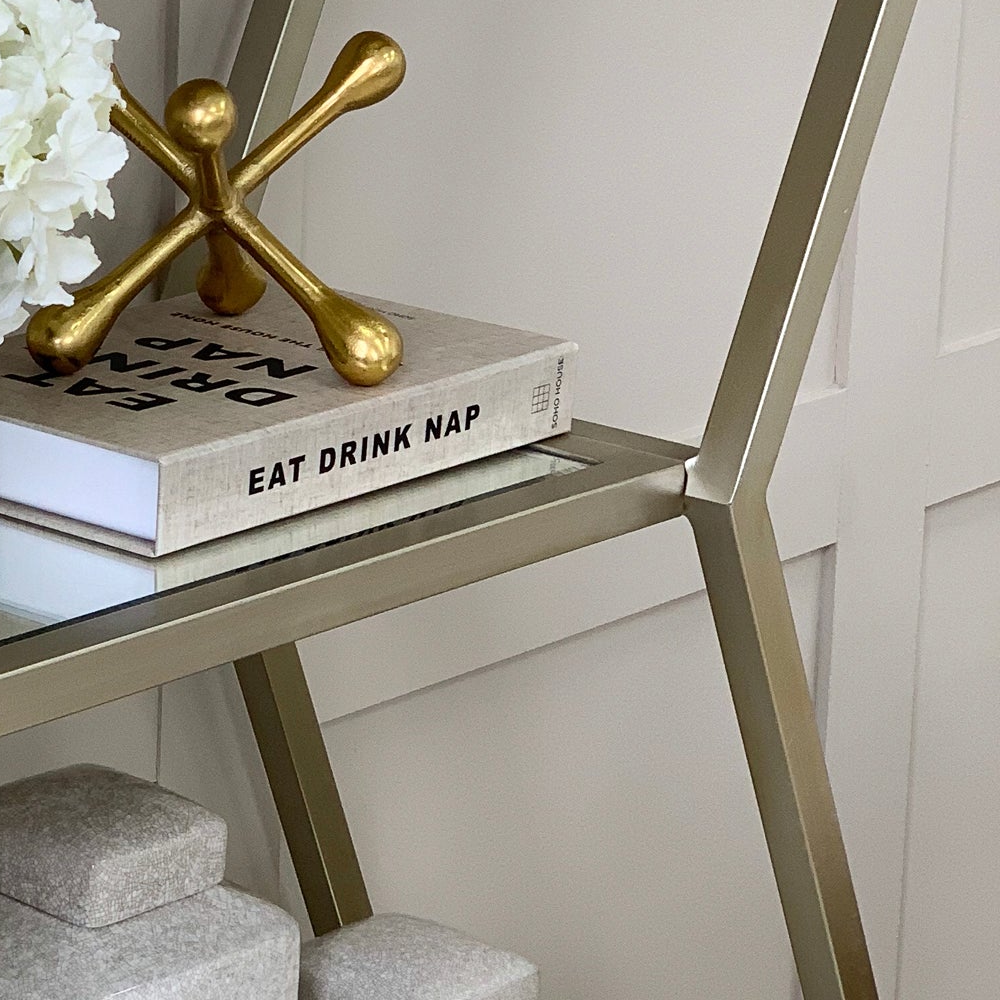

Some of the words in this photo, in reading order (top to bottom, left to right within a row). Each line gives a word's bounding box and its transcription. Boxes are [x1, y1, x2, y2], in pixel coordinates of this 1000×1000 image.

[223, 324, 278, 339] HOUSE
[278, 336, 314, 349] THE
[134, 337, 319, 379] NAP
[555, 356, 564, 395] HOUSE
[1, 372, 179, 412] EAT
[88, 352, 298, 407] DRIN
[551, 398, 560, 429] SOHO
[248, 454, 306, 496] EAT
[318, 423, 413, 475] DRINK
[424, 404, 481, 443] NAP
